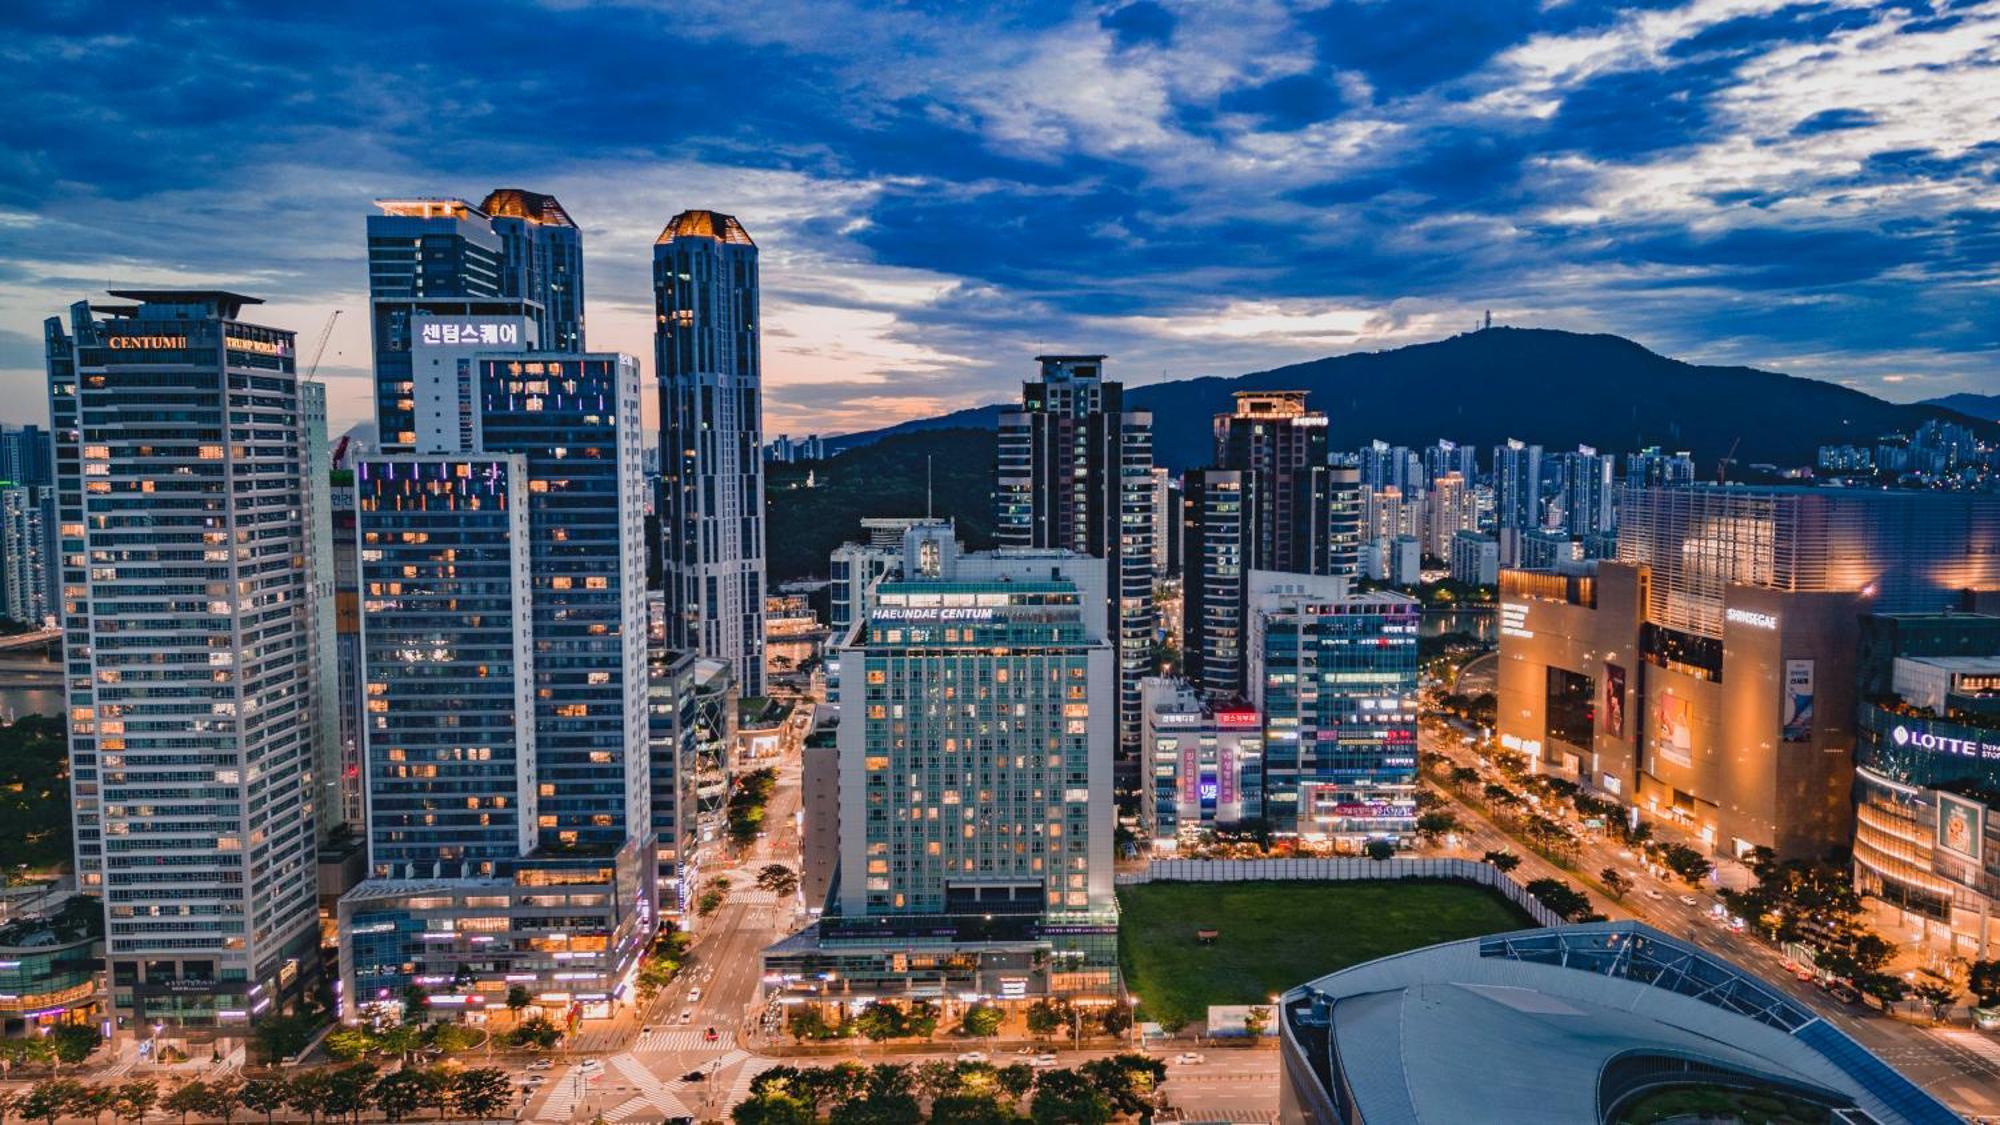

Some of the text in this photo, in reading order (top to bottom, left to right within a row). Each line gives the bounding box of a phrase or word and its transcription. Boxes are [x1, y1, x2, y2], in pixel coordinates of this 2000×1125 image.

[422, 324, 517, 344] 센텀스퀘어
[226, 337, 277, 353] TRUMP WORLD
[872, 609, 937, 619] HAEUNDAE
[940, 608, 993, 619] CENTUM
[1727, 608, 1777, 629] SHINSEGAE
[1911, 731, 1977, 756] LOTTE
